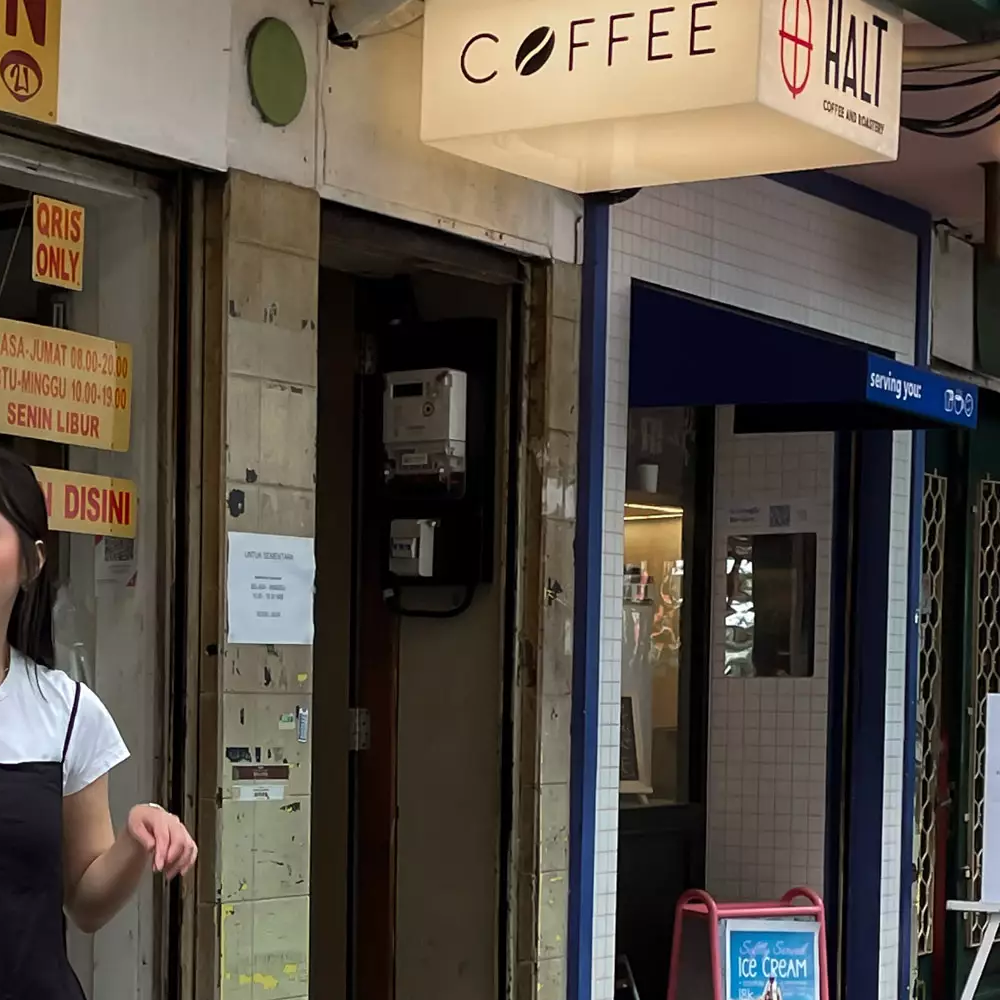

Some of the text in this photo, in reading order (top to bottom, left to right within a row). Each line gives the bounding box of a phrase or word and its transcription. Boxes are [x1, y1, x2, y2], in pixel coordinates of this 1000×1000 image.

[824, 0, 889, 108] HALT
[823, 100, 845, 119] COFFEE
[846, 109, 857, 123] AND
[37, 202, 82, 243] QRIS
[36, 243, 80, 283] ONLY
[70, 346, 128, 380] 08.00-20.00
[71, 379, 127, 410] 10.00-19.00
[870, 371, 902, 399] serving
[7, 402, 100, 439] SENIN LIBUR
[64, 484, 130, 525] DISINI
[738, 956, 808, 978] ICE CREAM
